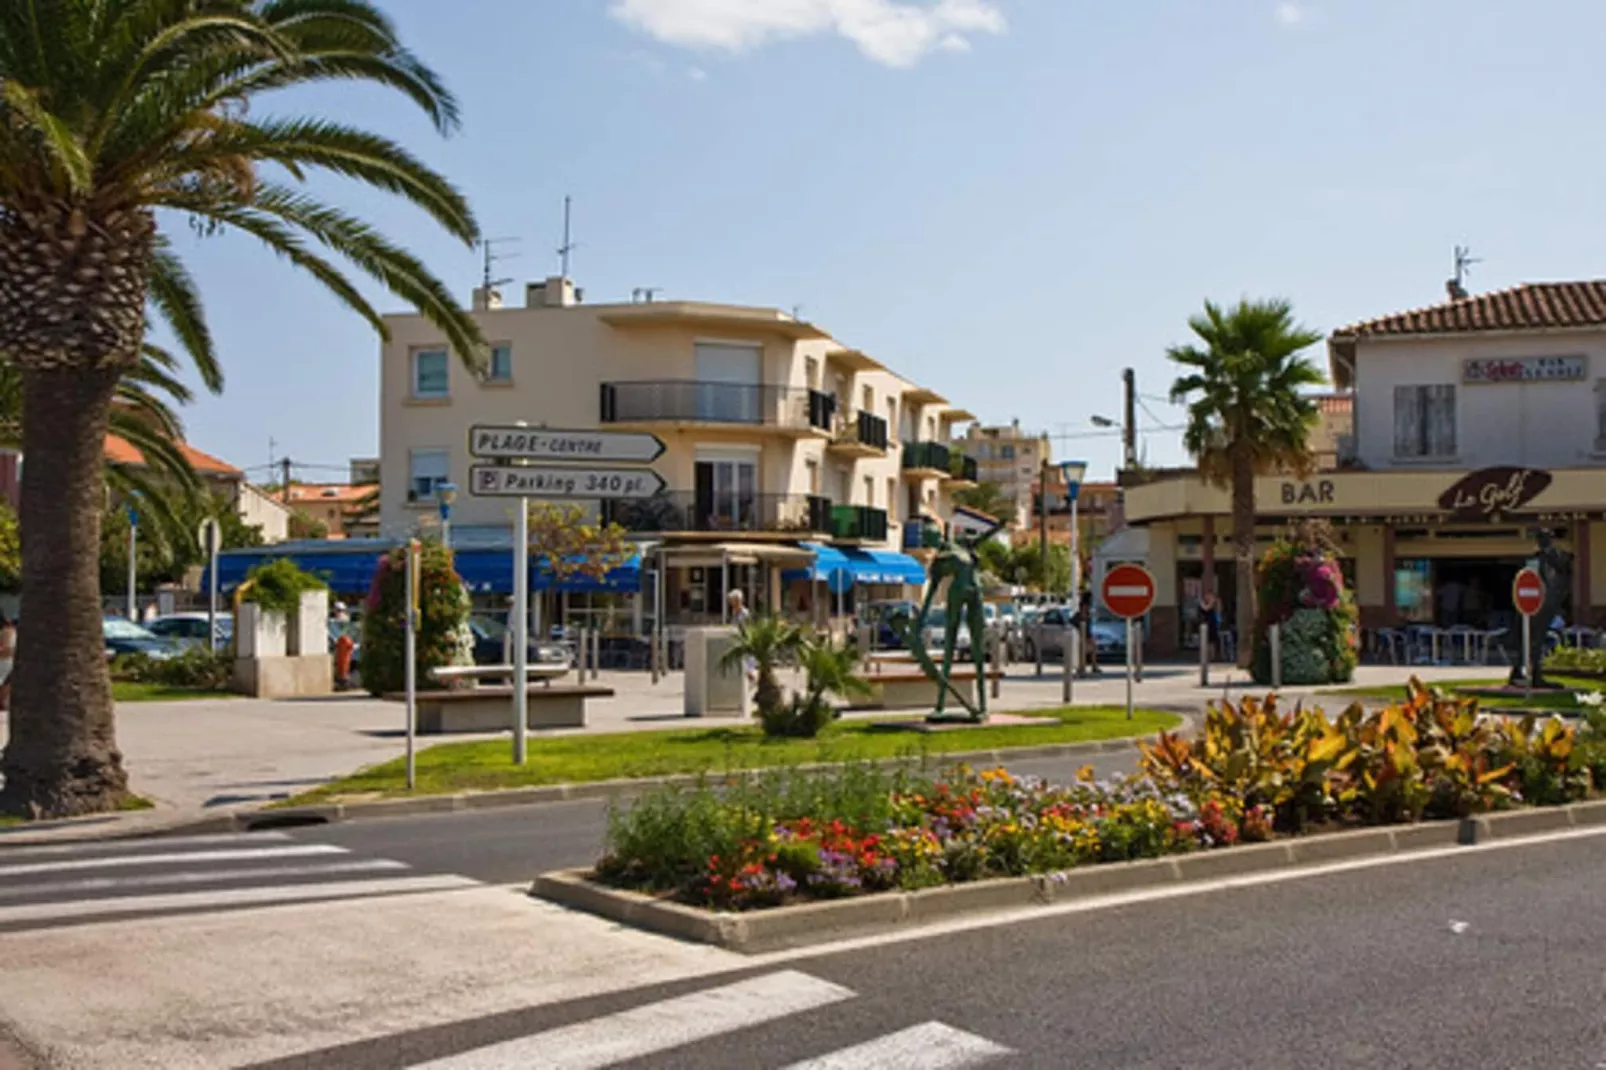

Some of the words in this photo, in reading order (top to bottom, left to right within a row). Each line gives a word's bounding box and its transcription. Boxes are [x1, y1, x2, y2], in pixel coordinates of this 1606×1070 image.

[504, 474, 575, 493] Parking
[585, 475, 621, 491] 340
[1281, 481, 1335, 504] BAR
[1479, 469, 1532, 514] Golf
